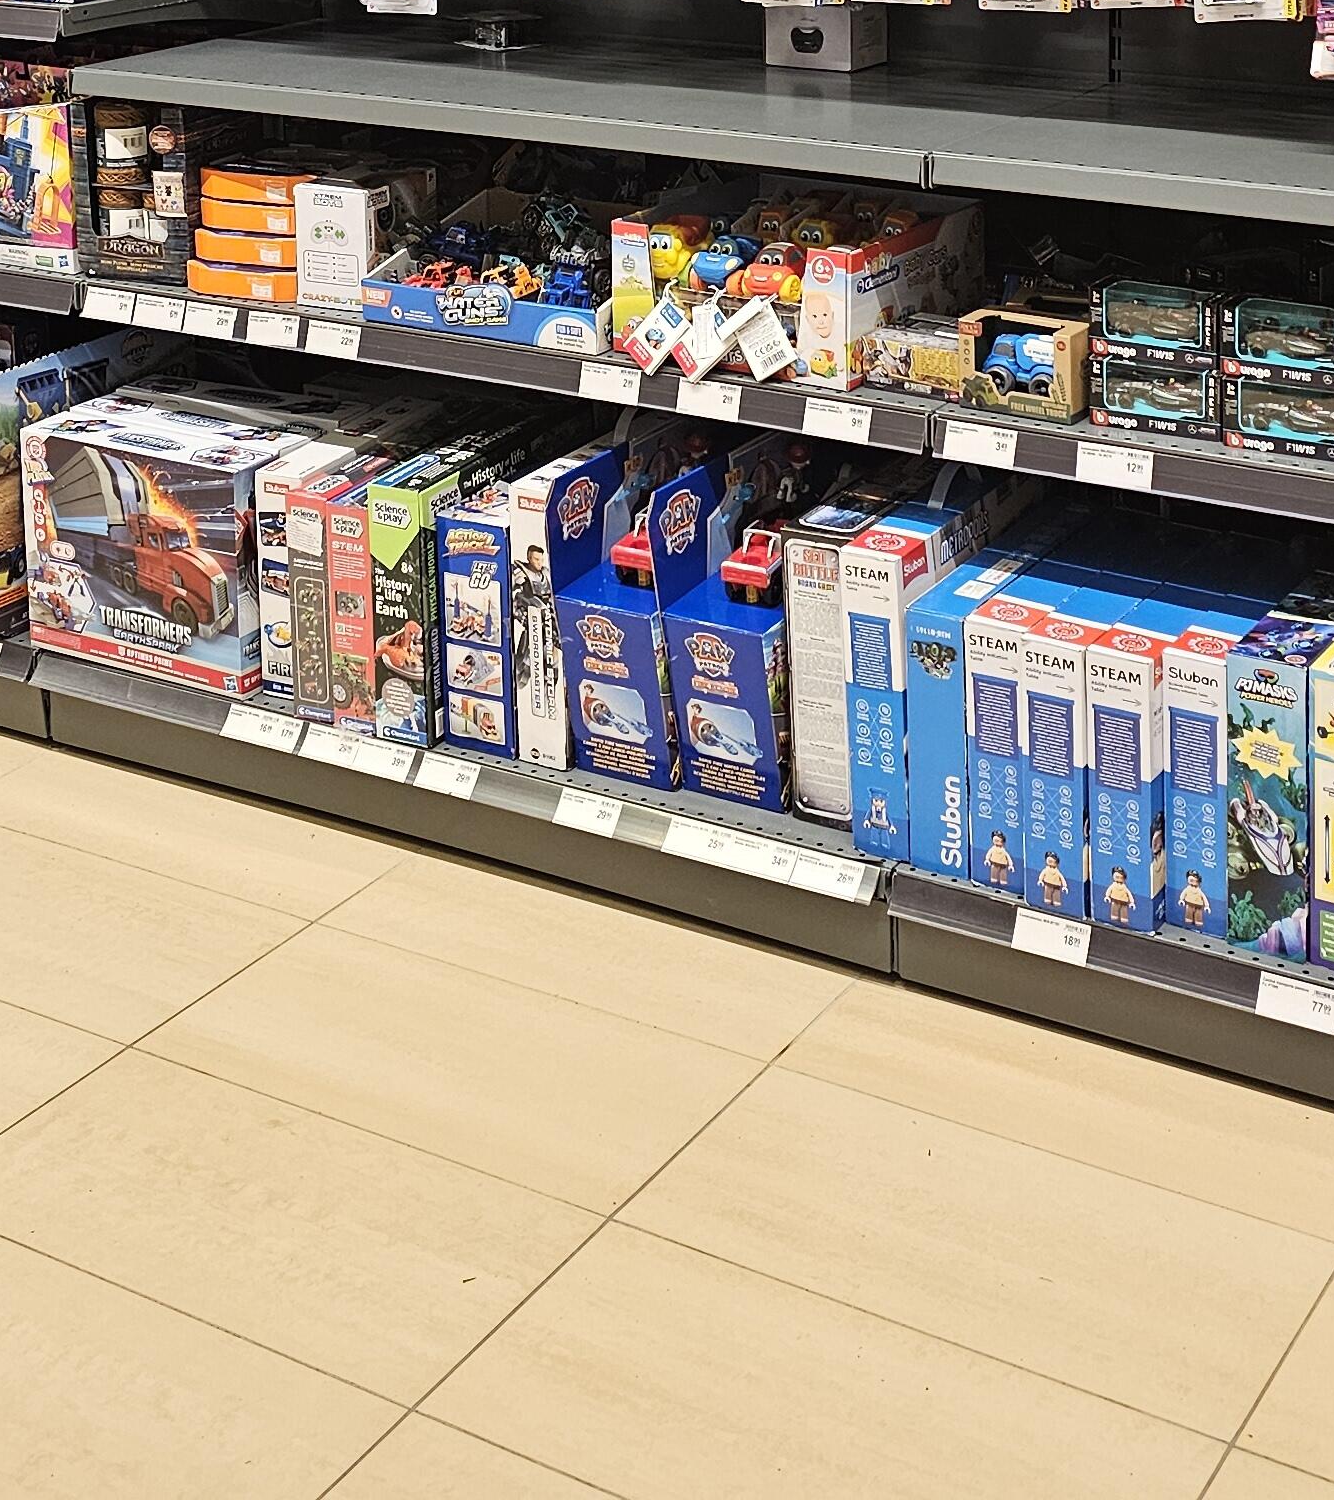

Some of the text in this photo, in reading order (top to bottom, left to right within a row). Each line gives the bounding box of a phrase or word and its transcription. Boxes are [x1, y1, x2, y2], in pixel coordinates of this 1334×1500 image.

[375, 502, 407, 516] Science
[561, 485, 598, 522] PAW
[662, 498, 698, 530] PAW
[333, 517, 360, 529] Science
[332, 540, 364, 552] STEM
[469, 572, 491, 590] GO
[845, 564, 890, 583] STEAM
[375, 575, 413, 595] History
[385, 590, 402, 602] life
[376, 602, 409, 619] Earth
[99, 605, 193, 644] TRANSFORMERS
[577, 621, 626, 648] PAW
[113, 628, 181, 654] EARTHSPARK
[686, 638, 734, 666] PAW
[968, 632, 1018, 655] STEAM
[1025, 650, 1075, 673] STEAM
[1090, 664, 1142, 686] STEAM
[1168, 666, 1219, 689] Sluban
[1240, 690, 1294, 708] POWER HEROES
[1250, 682, 1298, 701] MASKS
[940, 775, 962, 868] Sluban
